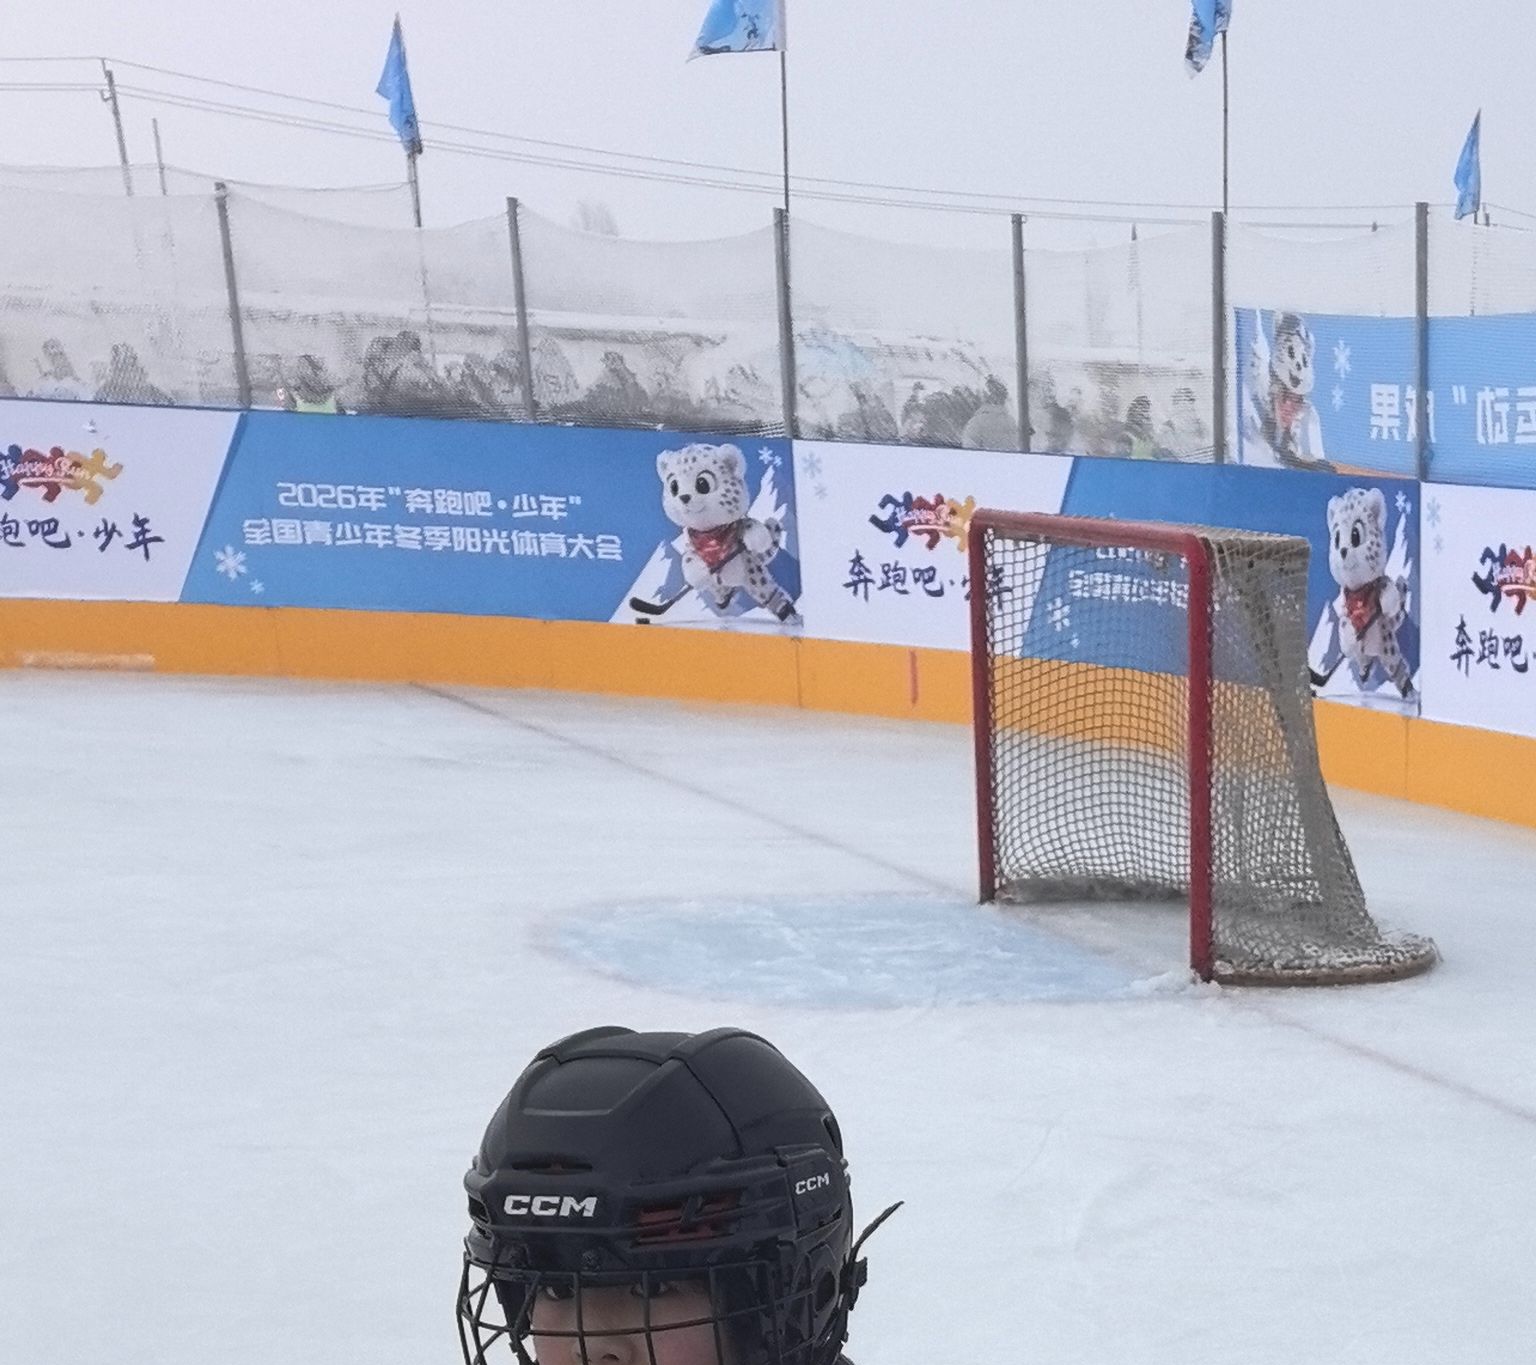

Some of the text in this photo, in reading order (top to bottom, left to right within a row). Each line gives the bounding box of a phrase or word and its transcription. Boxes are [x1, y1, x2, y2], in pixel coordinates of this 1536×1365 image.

[242, 517, 624, 562] 全国青少年冬季阳光体育大会
[794, 1172, 830, 1196] CCM
[503, 1194, 598, 1218] CCM
